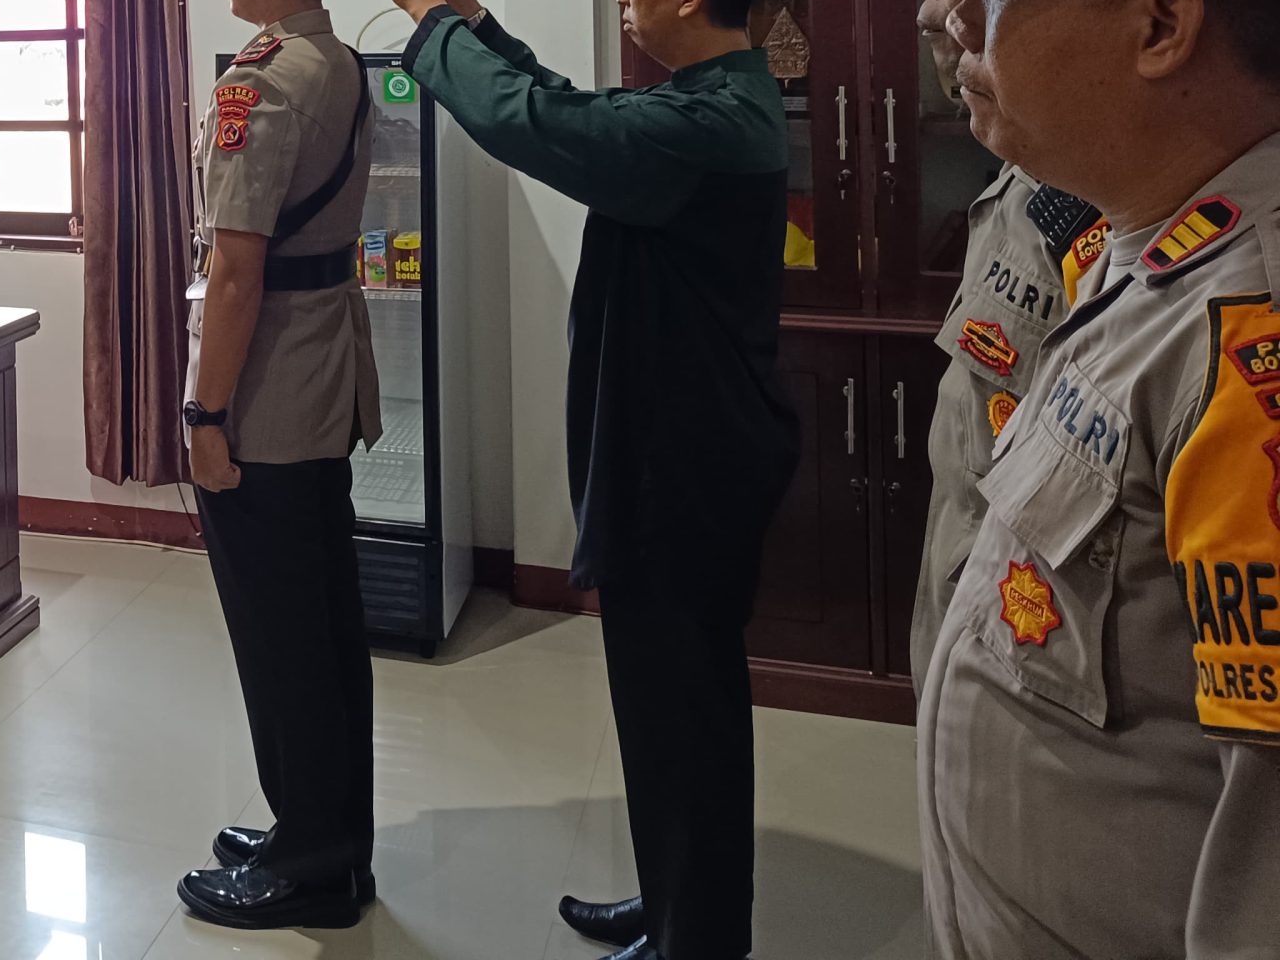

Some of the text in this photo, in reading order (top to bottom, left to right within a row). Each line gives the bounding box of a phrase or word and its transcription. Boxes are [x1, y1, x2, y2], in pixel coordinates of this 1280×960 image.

[219, 87, 255, 99] POLRES
[1075, 225, 1112, 253] POL
[1078, 241, 1106, 261] BOVE
[983, 260, 1054, 321] POLRI
[1250, 352, 1280, 373] BO
[1047, 376, 1120, 466] POLRI
[1198, 660, 1279, 703] OLRES
